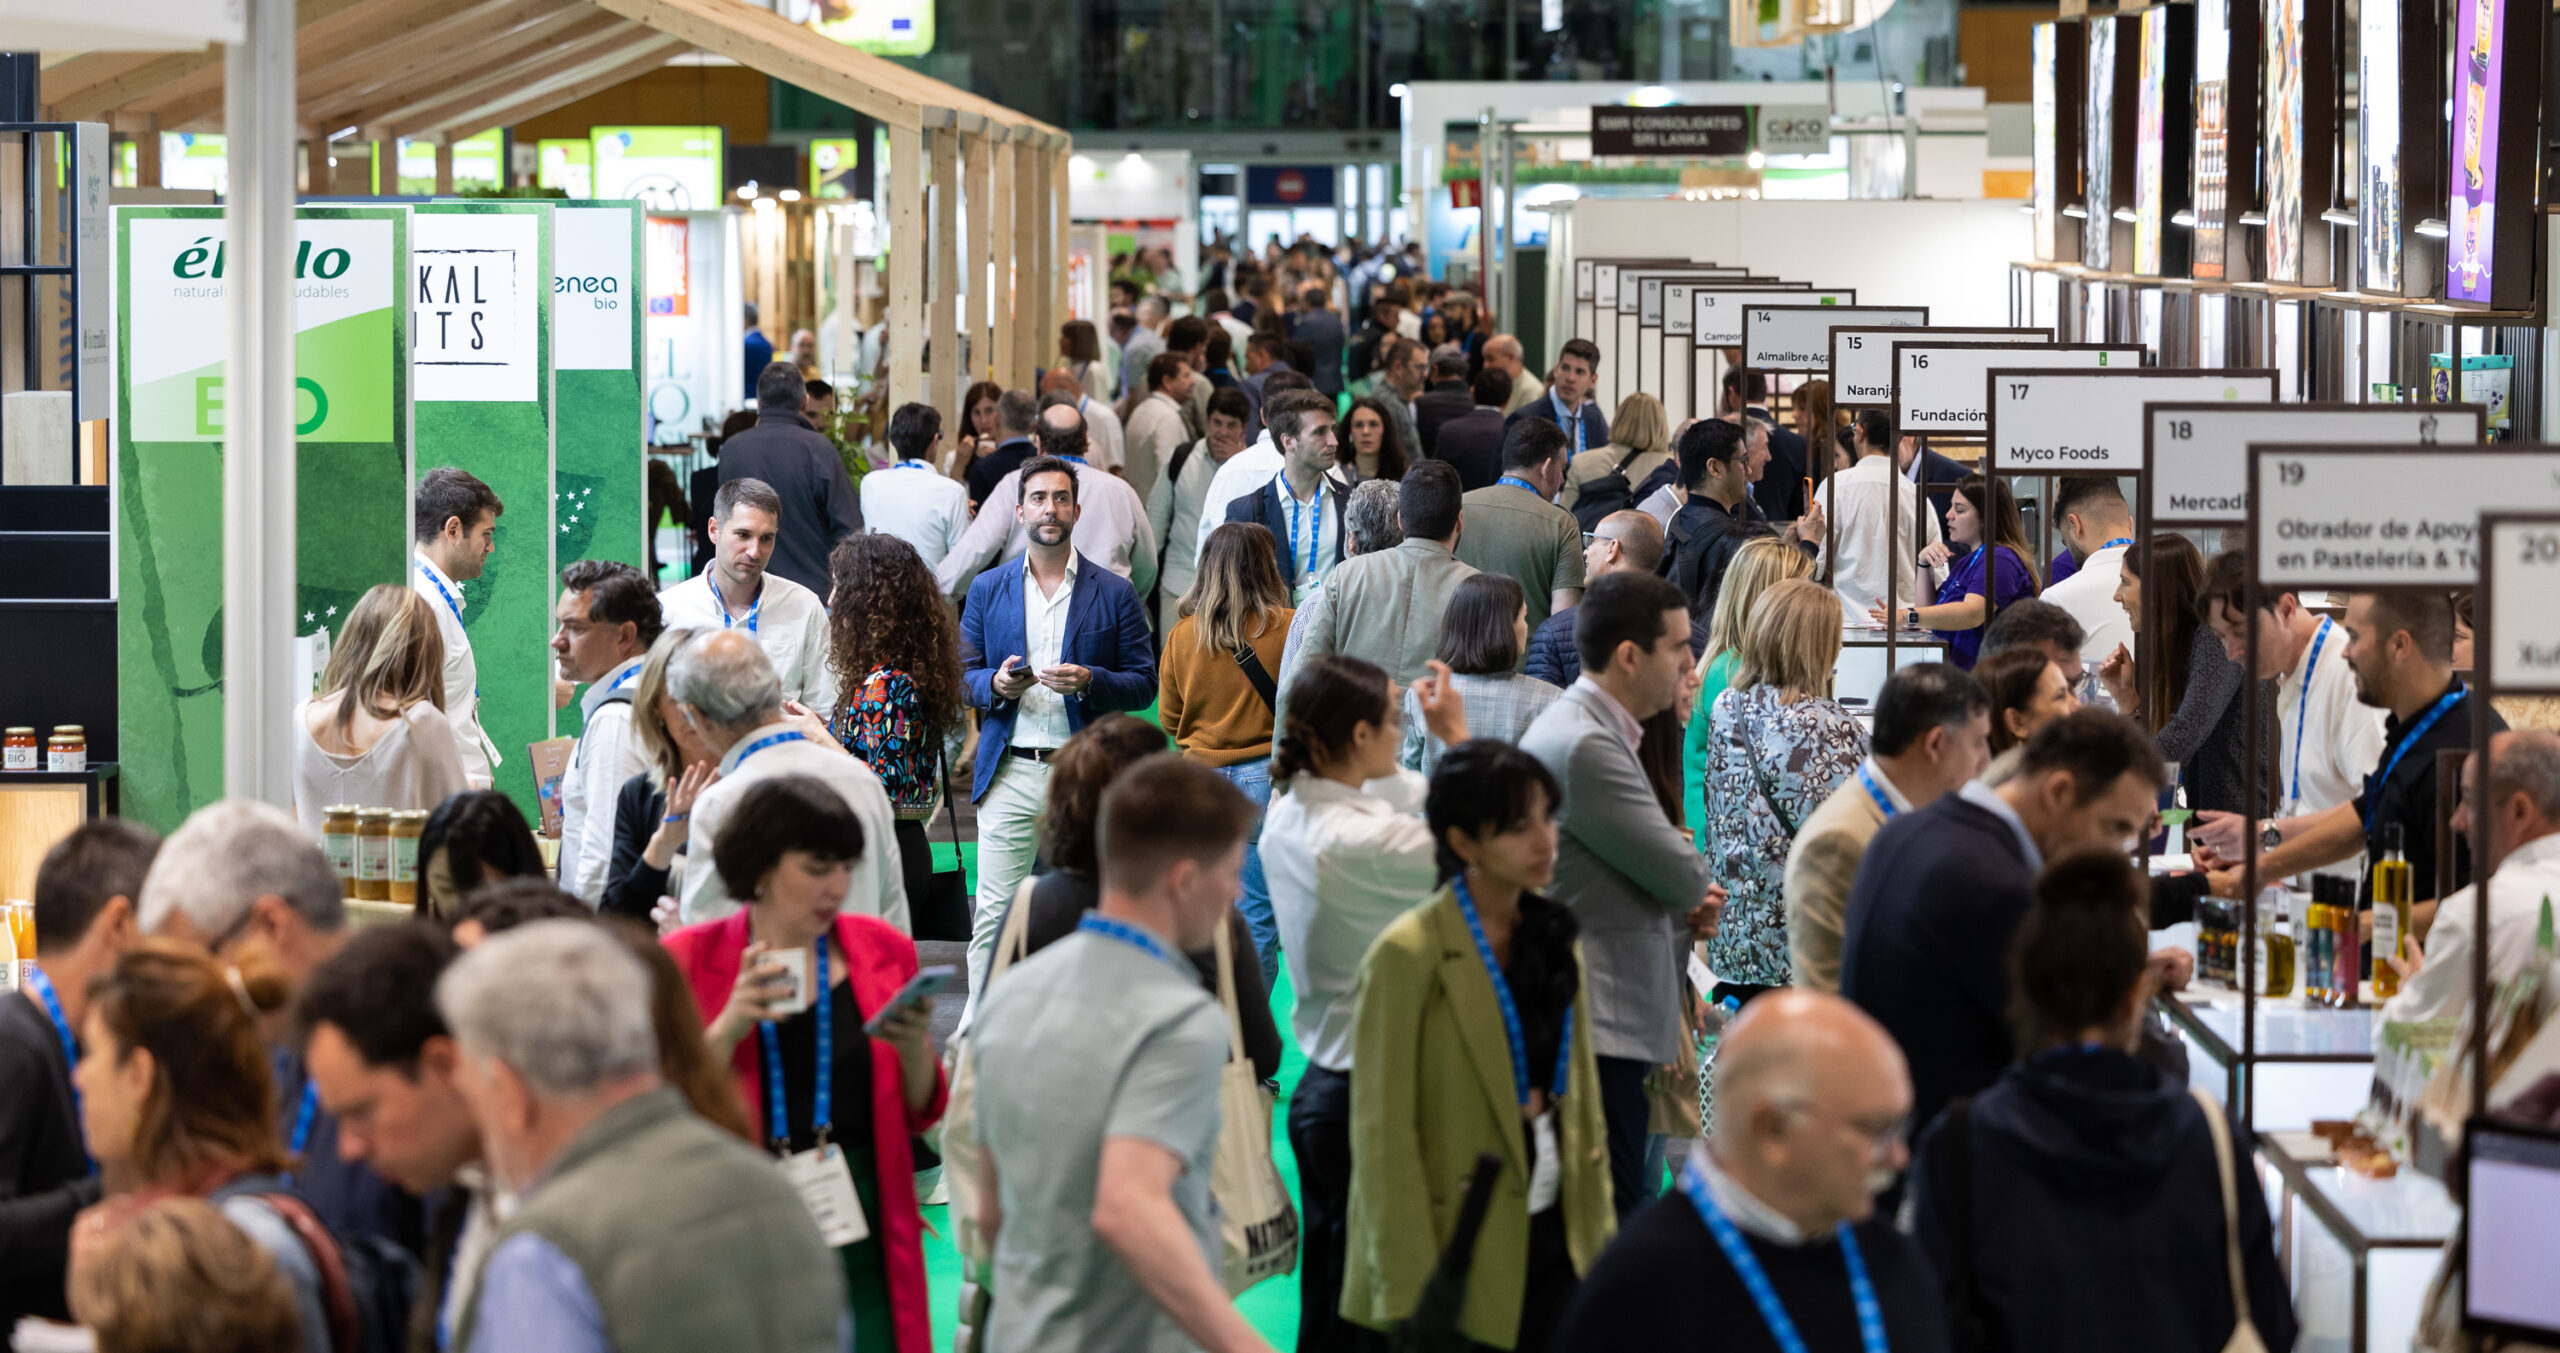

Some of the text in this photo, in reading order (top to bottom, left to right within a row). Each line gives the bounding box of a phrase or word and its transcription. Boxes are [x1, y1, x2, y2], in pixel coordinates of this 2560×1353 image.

[1632, 115, 1743, 131] CONSOLIDATED
[1658, 131, 1710, 147] LANKA
[173, 285, 350, 298] natural udables
[419, 265, 487, 304] KAL
[1648, 282, 1657, 291] 11
[1672, 288, 1682, 298] 12
[594, 297, 618, 310] bio
[1704, 297, 1715, 307] 13
[1757, 311, 1771, 323] 14
[1847, 336, 1863, 350] 15
[1756, 351, 1829, 365] Almalibre Aça
[1911, 354, 1929, 369] 16
[2009, 384, 2029, 400] 17
[195, 376, 329, 436] BO
[1911, 408, 1988, 422] Fundación
[2168, 420, 2193, 440] 18
[2010, 446, 2109, 463] Myco Foods
[2277, 461, 2305, 486] 19
[2277, 518, 2373, 541] Obrador
[2379, 518, 2408, 541] de
[2519, 535, 2560, 565] 20
[2277, 551, 2306, 570] en
[2434, 549, 2449, 570] &
[7, 754, 26, 763] BIO
